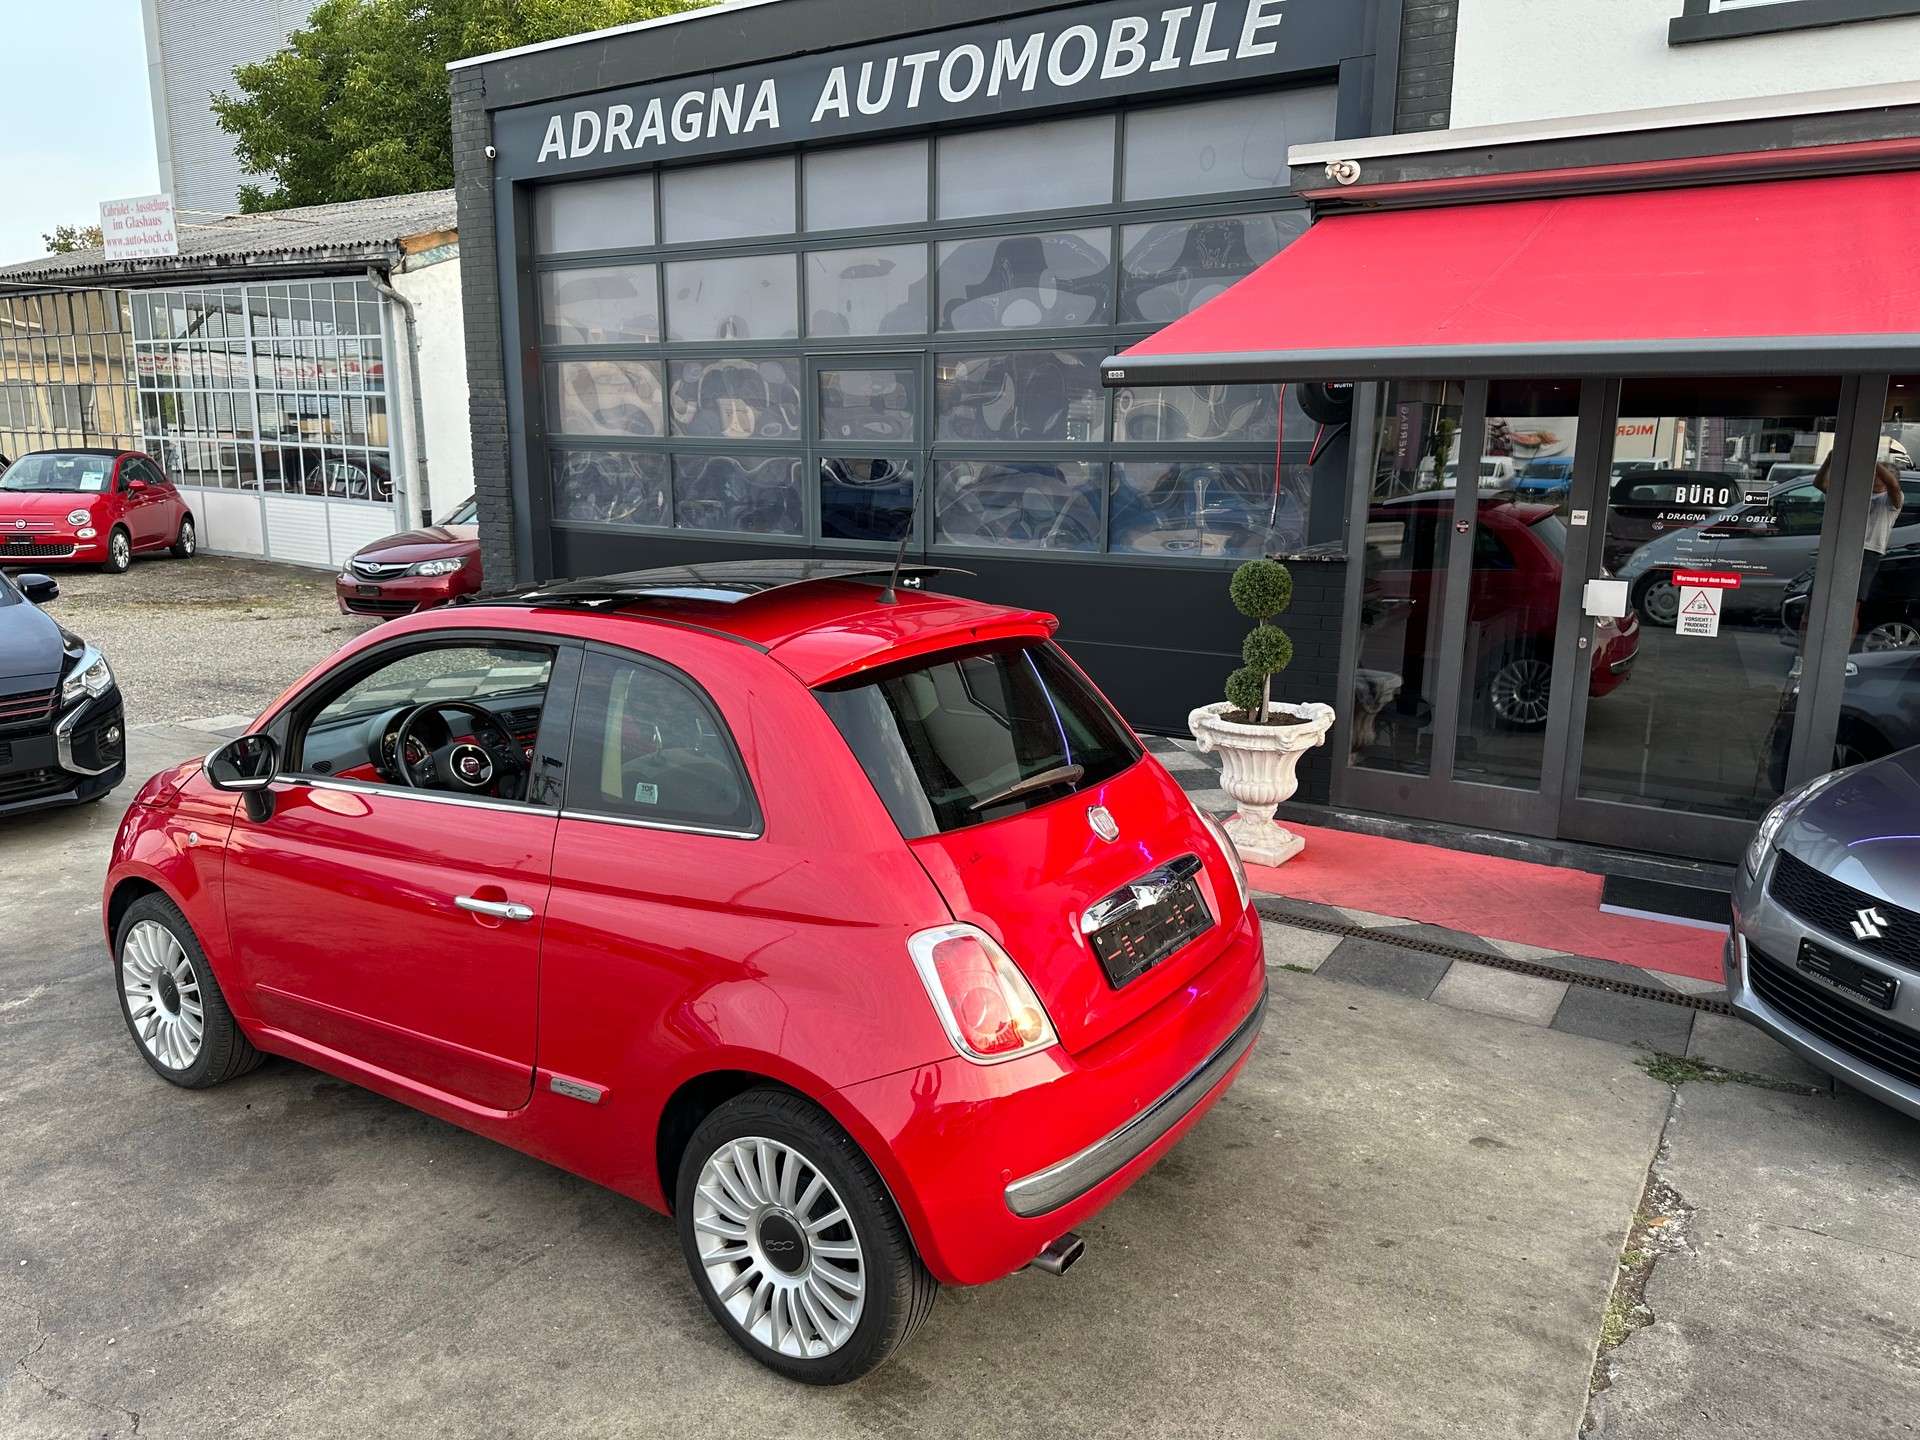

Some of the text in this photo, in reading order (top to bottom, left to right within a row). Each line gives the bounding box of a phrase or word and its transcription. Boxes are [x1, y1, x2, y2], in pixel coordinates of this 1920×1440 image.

[536, 0, 1287, 163] ADRAGNA AUTOMOBILE
[102, 203, 129, 217] Cabriolet
[135, 199, 170, 213] Ausstellung
[112, 215, 162, 230] im Glashaus
[106, 229, 174, 247] www.auto-koch.ch
[1675, 484, 1730, 505] BÜRO
[1676, 575, 1699, 583] Warnung
[560, 1081, 592, 1100] 500
[765, 1239, 795, 1252] 500
